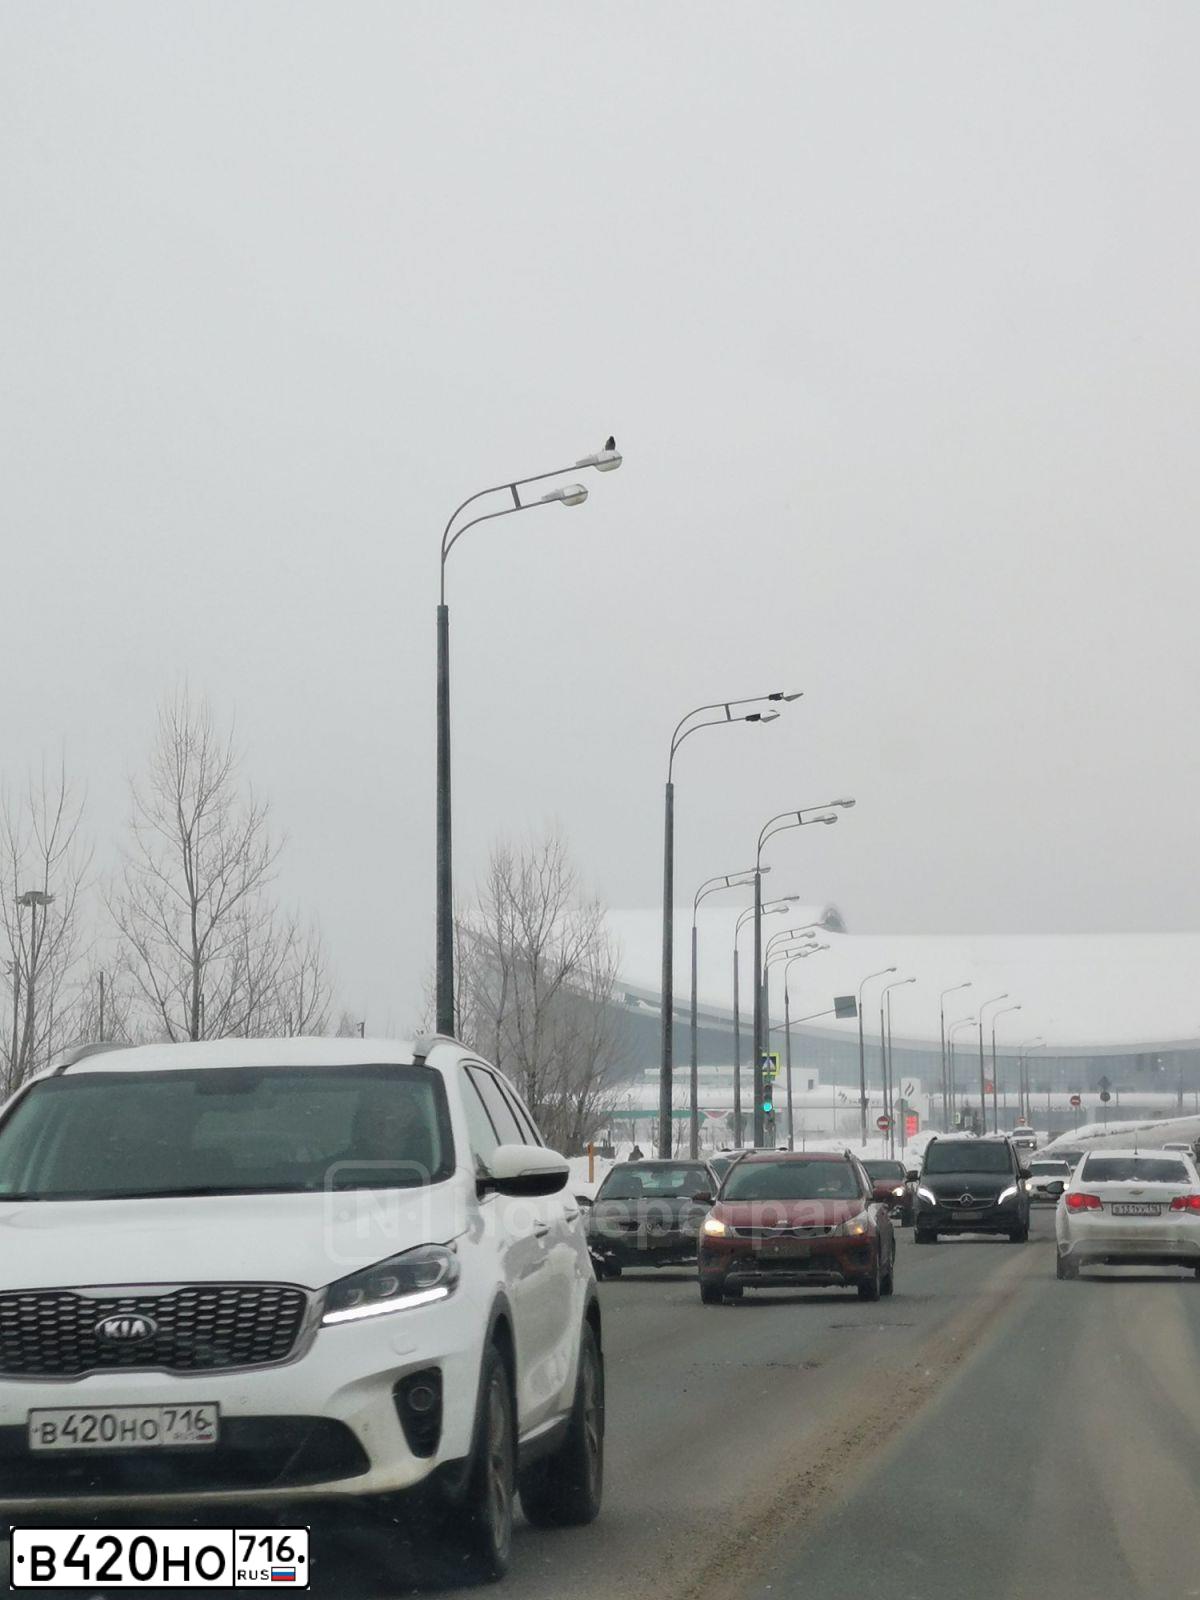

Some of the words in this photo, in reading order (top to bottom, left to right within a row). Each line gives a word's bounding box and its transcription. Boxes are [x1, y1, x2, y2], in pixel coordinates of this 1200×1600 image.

[104, 1320, 147, 1338] KIA
[41, 1414, 158, 1444] В420НО
[163, 1408, 208, 1431] 716
